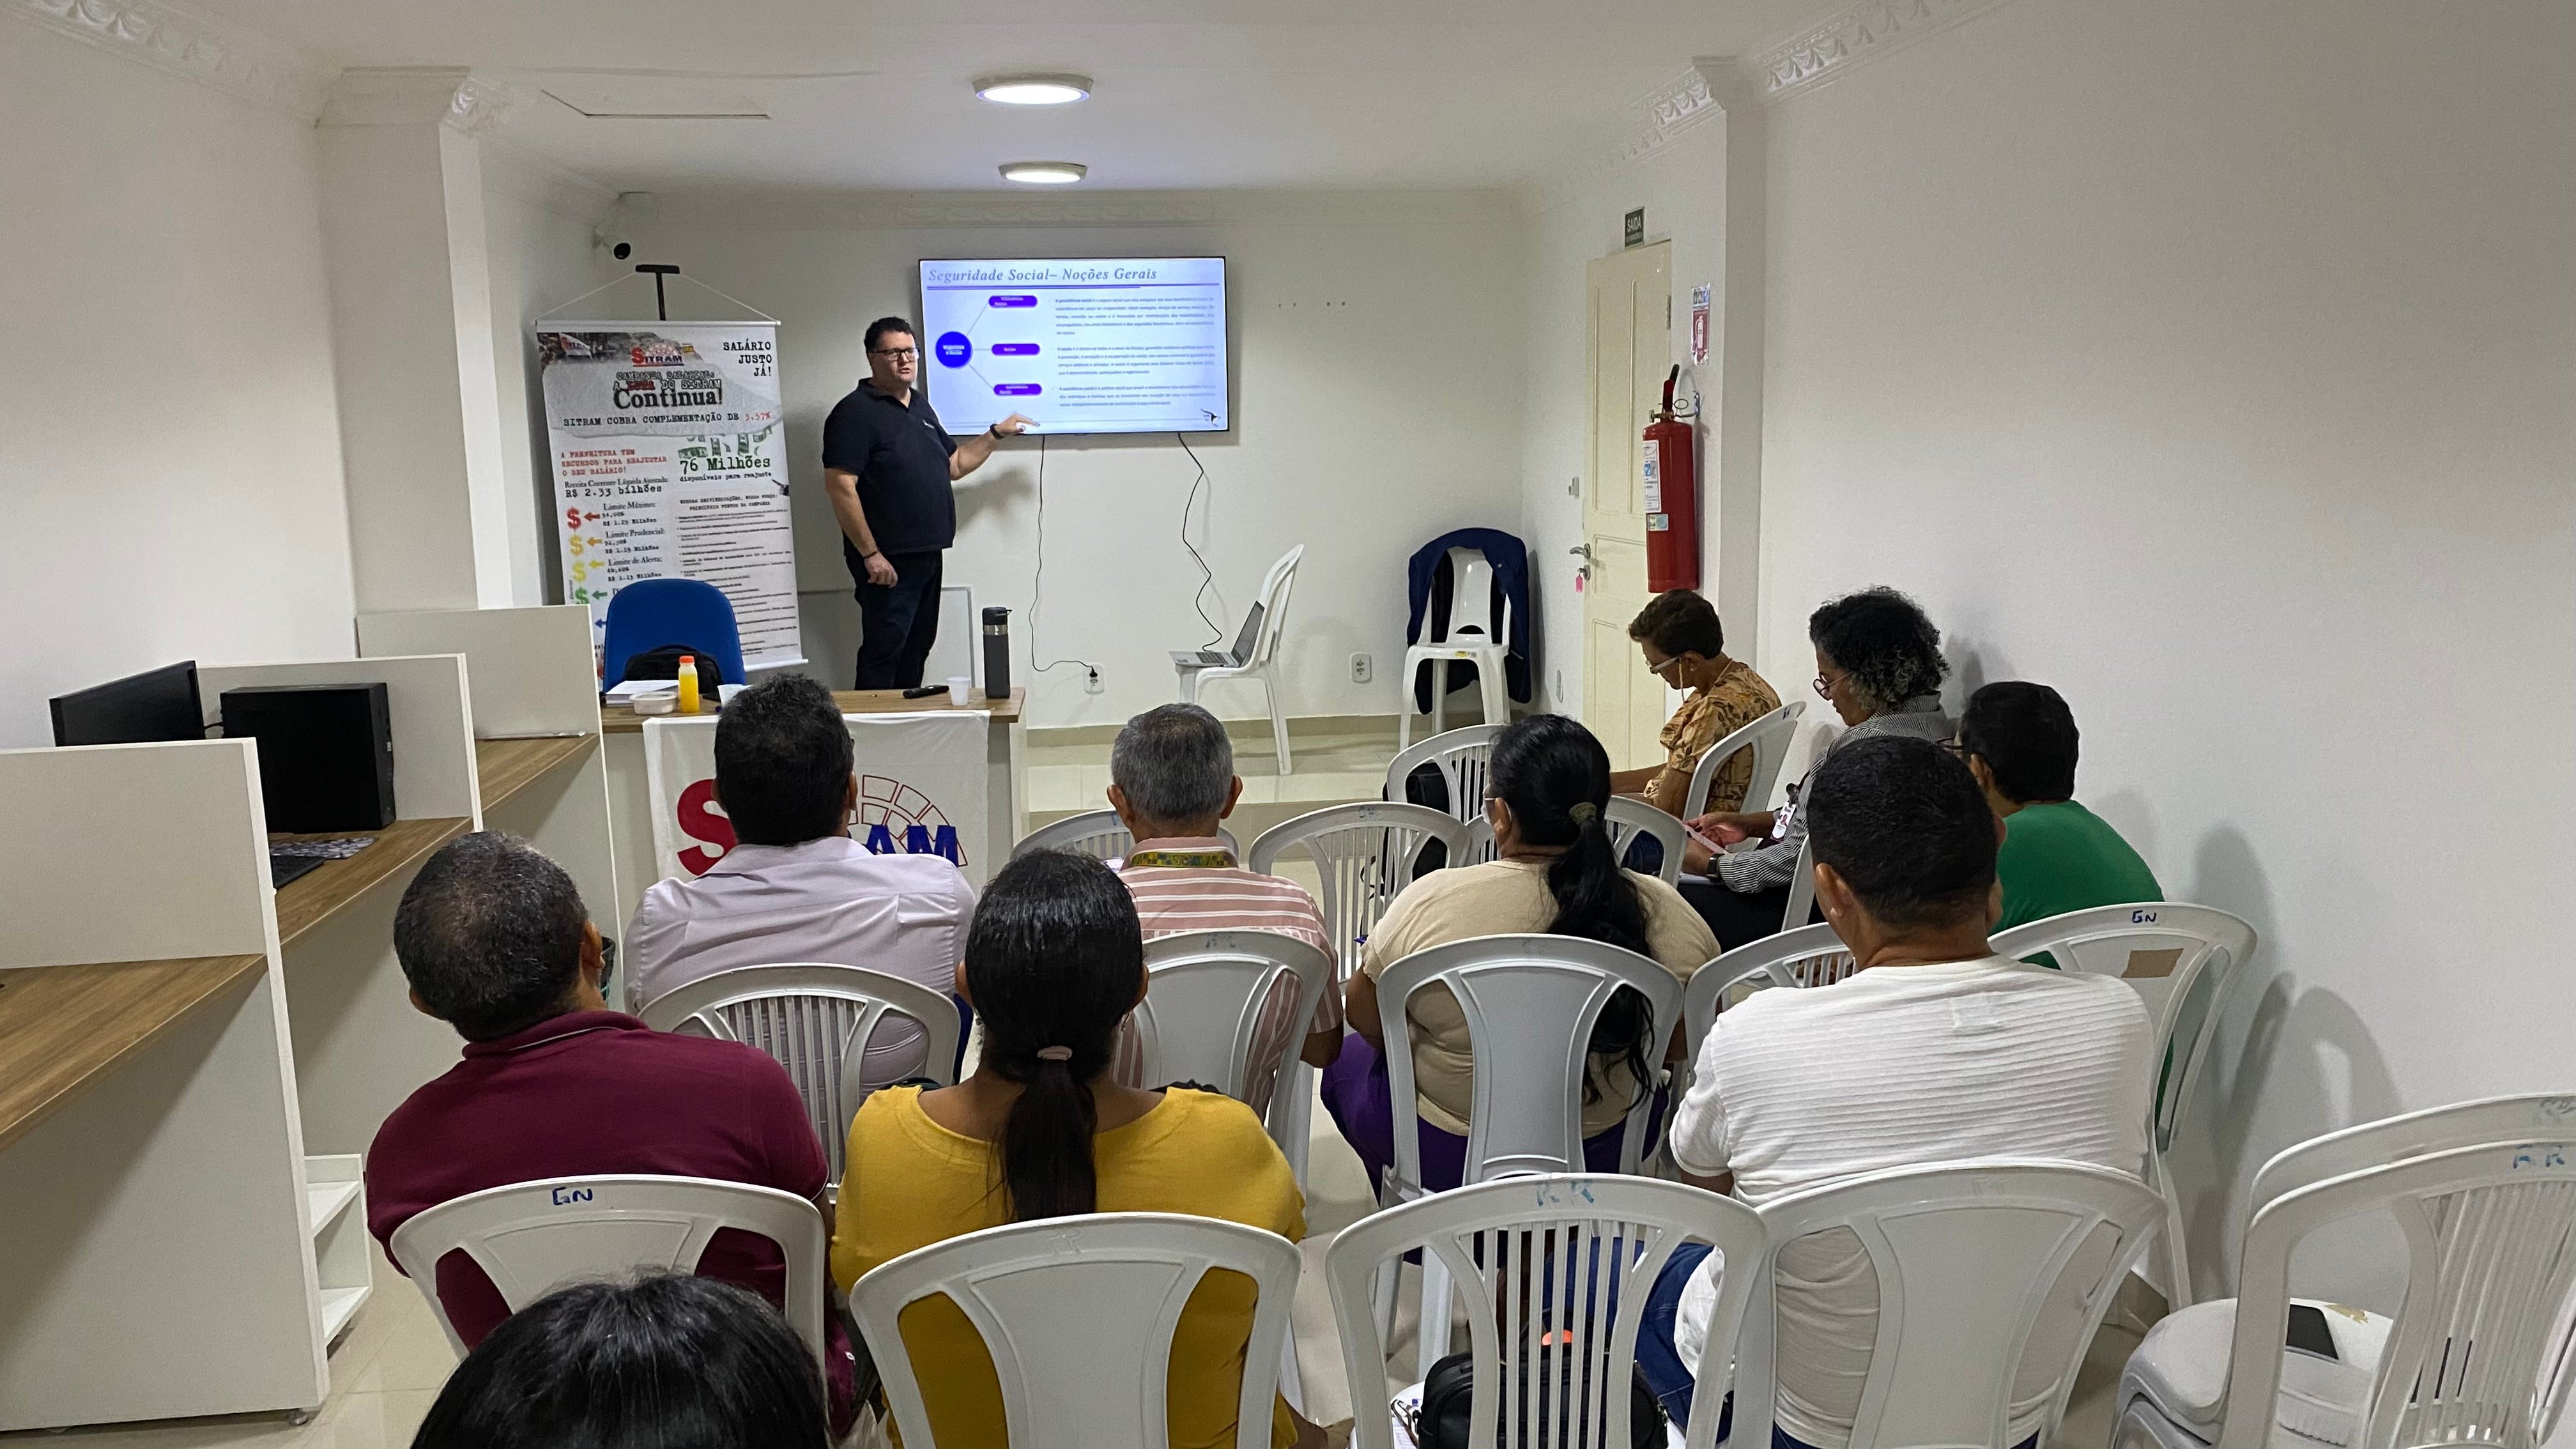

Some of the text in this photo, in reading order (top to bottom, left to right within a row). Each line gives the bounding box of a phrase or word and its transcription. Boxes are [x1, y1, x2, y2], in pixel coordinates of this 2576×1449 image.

[929, 269, 1003, 283] Seguridade
[1062, 268, 1108, 282] Noções
[1114, 268, 1157, 279] Gerais
[723, 338, 771, 351] SALÁRIO
[631, 347, 683, 364] SITRAM
[739, 355, 772, 364] JUSTO
[754, 364, 772, 376] JÁ!
[613, 381, 620, 391] A
[661, 379, 676, 390] DO
[681, 379, 722, 390] SITRAM
[613, 387, 722, 410] Continua!
[564, 418, 601, 426] SITRAM
[607, 417, 637, 425] COBRA
[643, 412, 722, 423] COMPLEMENTAÇÃO
[570, 450, 617, 458] PREFEITURA
[590, 466, 627, 475] SALÁRIO!
[680, 456, 770, 475] 76 Milhões
[679, 473, 722, 482] disponíveis
[564, 480, 586, 489] Receita
[618, 479, 641, 487] Líquida
[565, 484, 662, 498] R$ 2.33 bilhões
[608, 558, 631, 566] Limite
[552, 1186, 593, 1206] GN
